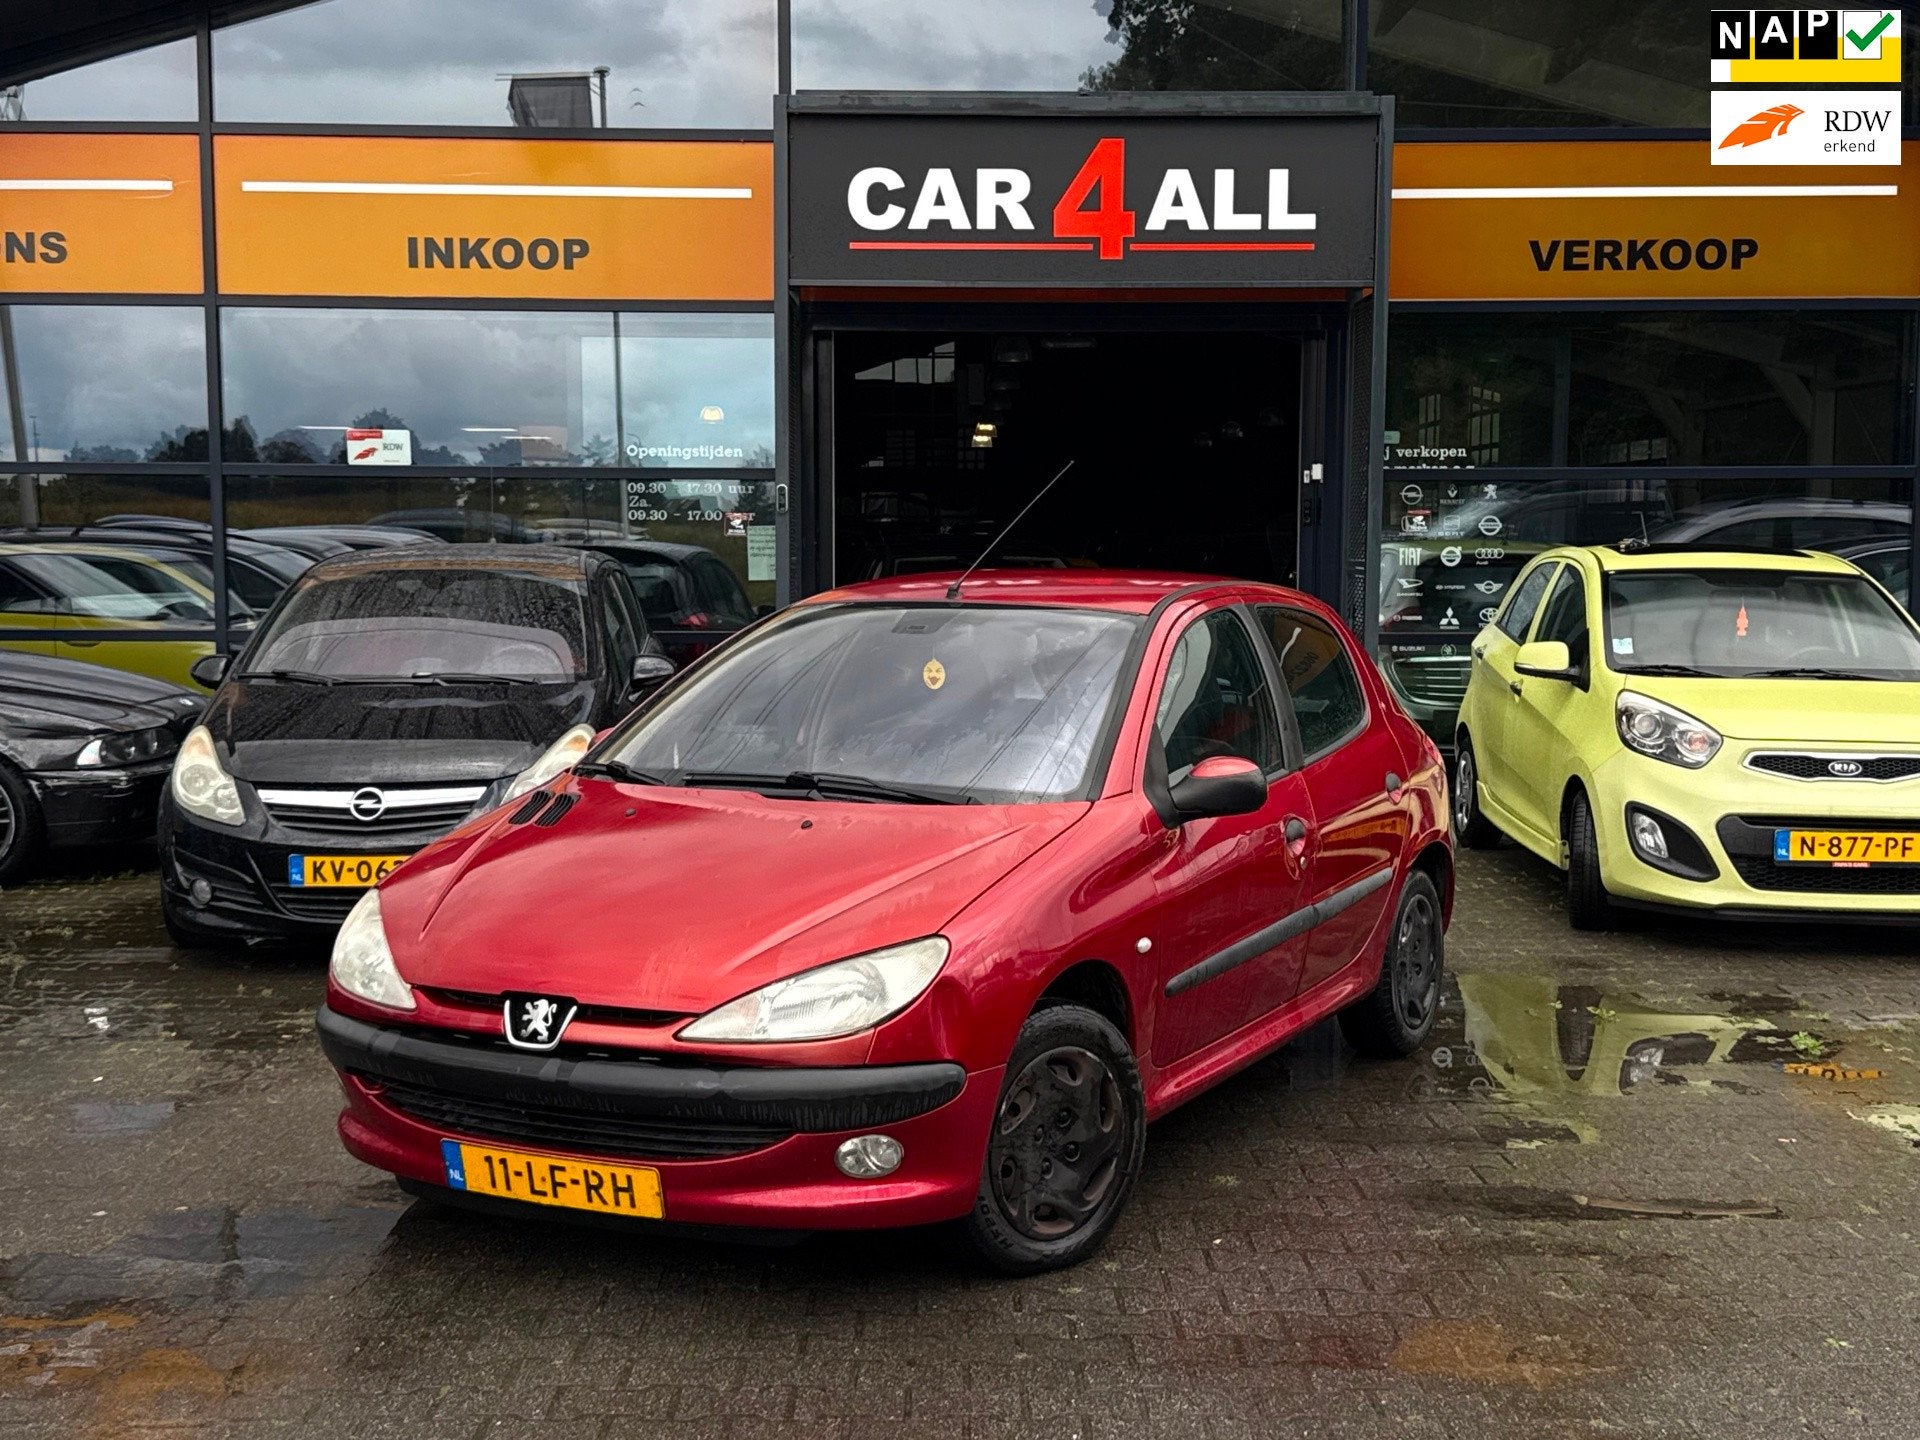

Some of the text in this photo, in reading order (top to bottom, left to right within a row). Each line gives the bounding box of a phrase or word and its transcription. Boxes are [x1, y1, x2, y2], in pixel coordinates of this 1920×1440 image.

[847, 137, 1317, 260] CAR 4 ALL
[407, 236, 590, 271] INKOOP
[1528, 238, 1760, 272] VERKOOP
[626, 444, 744, 460] Openingstijden
[1396, 445, 1468, 461] verkopen
[627, 482, 667, 494] 09.30
[728, 484, 755, 494] uur
[628, 509, 668, 521] 09.30
[687, 510, 723, 521] 17.00
[1399, 547, 1422, 566] FIAT
[1833, 763, 1857, 772] KIA
[1776, 836, 1915, 858] NL N-877-PF
[448, 1154, 637, 1210] NL 11-LF-RH
